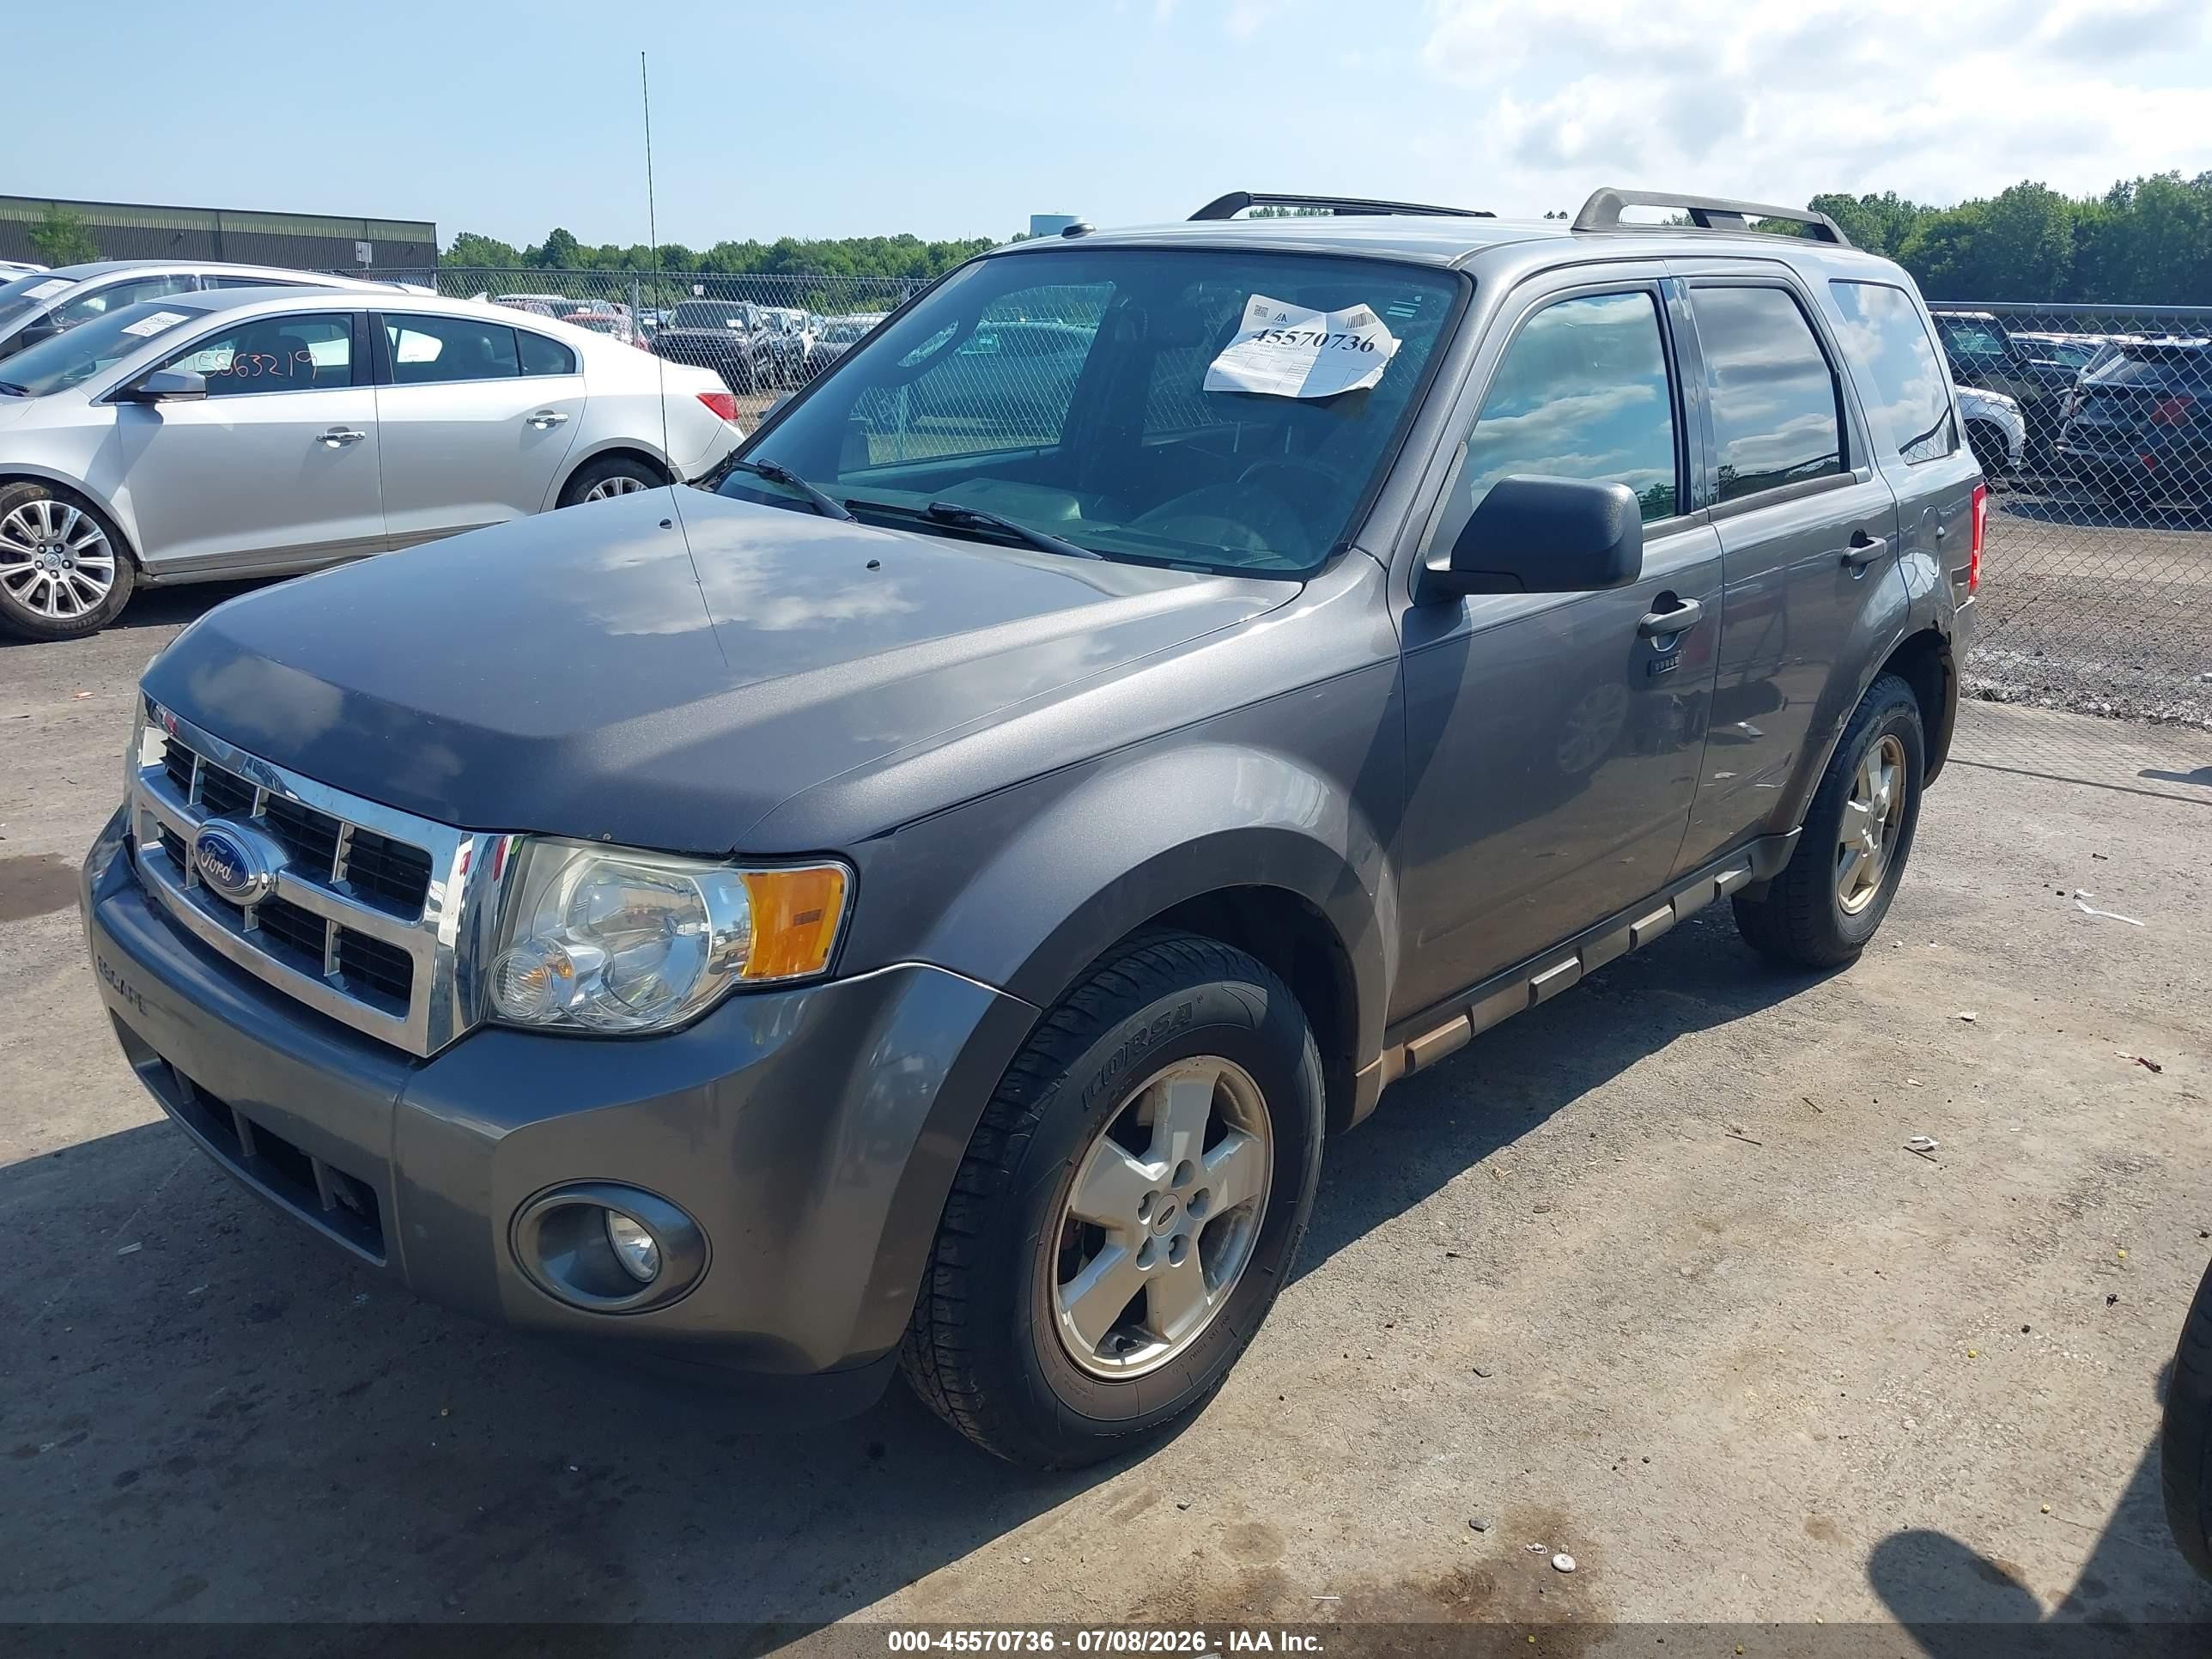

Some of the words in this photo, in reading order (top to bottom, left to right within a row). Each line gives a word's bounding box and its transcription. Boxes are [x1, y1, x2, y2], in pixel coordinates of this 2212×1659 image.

[1251, 328, 1376, 353] 45570736
[200, 840, 234, 882] Ford
[1082, 1001, 1193, 1113] CORSA
